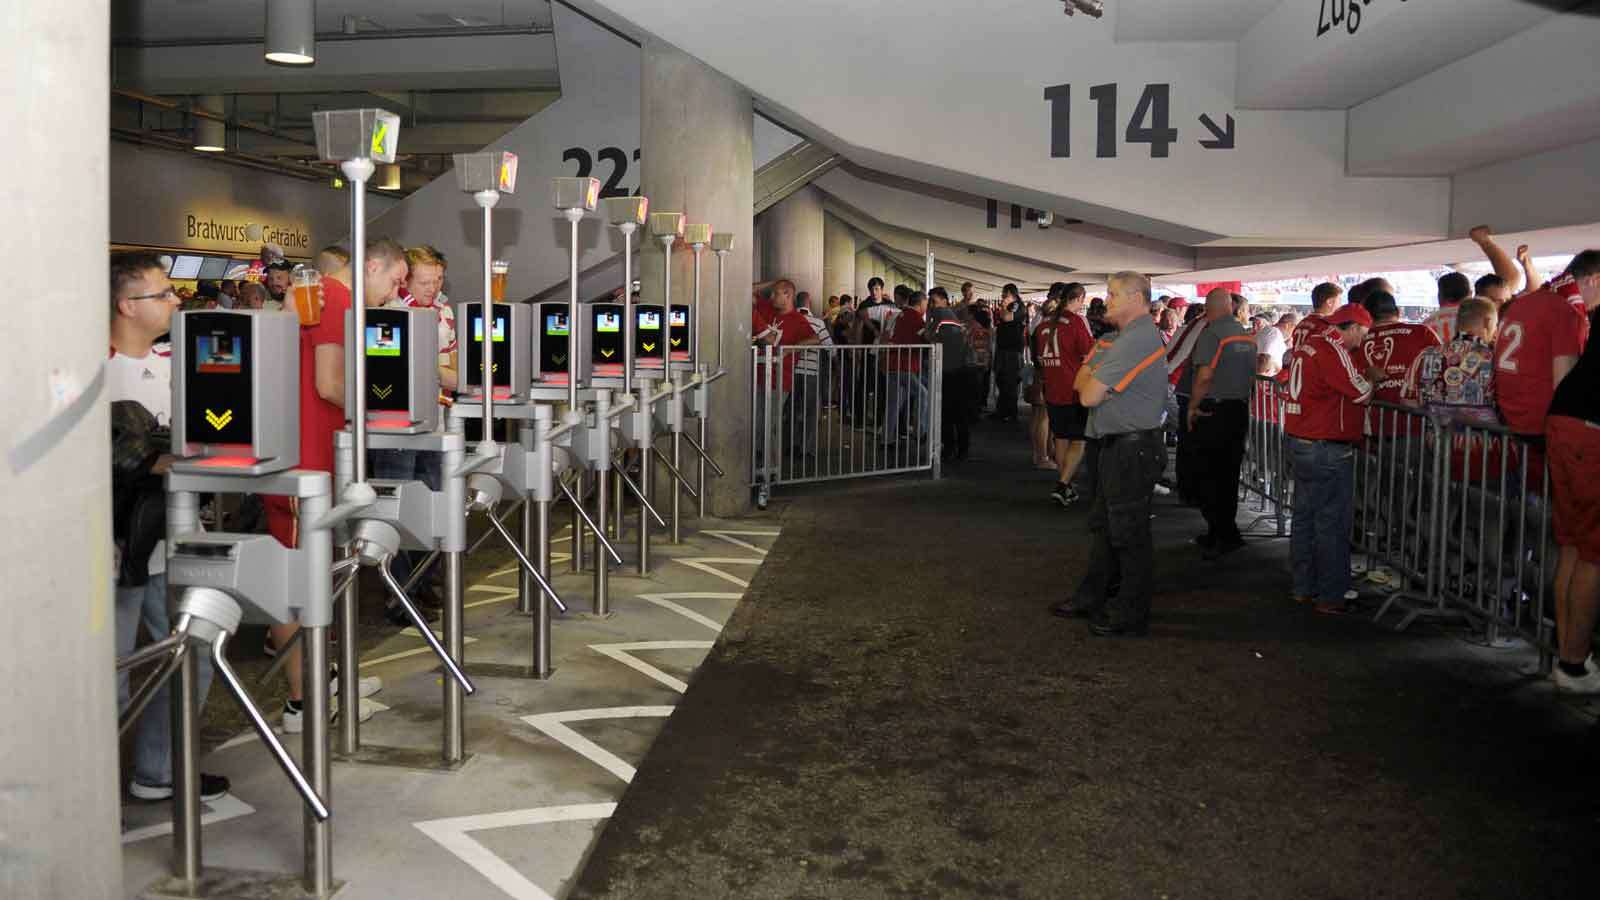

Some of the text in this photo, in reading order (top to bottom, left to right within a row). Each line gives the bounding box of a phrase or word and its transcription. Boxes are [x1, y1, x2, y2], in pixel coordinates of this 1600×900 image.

[1044, 83, 1178, 158] 114
[562, 147, 641, 198] 22
[1041, 327, 1061, 358] 21
